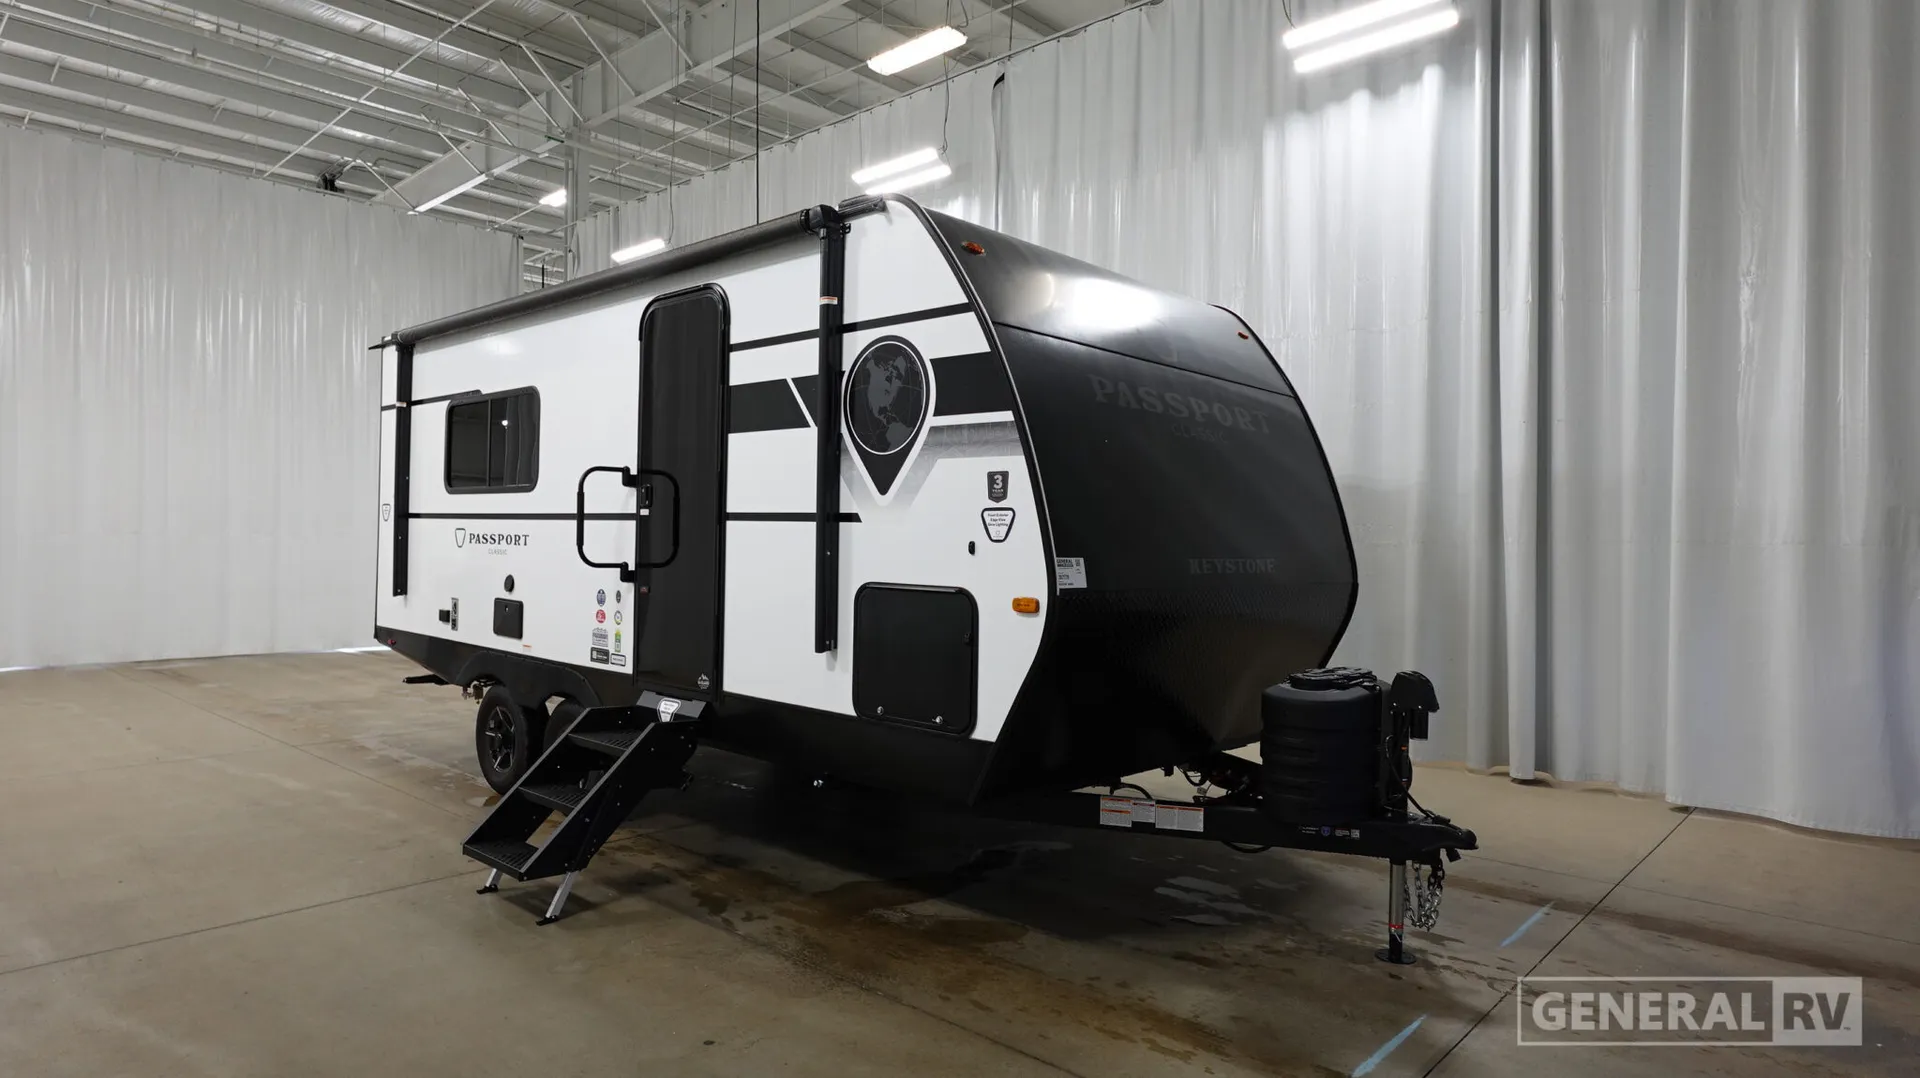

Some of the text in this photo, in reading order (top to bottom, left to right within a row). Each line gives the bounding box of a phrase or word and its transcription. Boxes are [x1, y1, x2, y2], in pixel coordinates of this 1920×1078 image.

[1086, 373, 1270, 434] PASSPORT
[993, 474, 1003, 489] 3
[469, 532, 530, 546] PASSPORT
[1187, 557, 1277, 575] KEYSTONE
